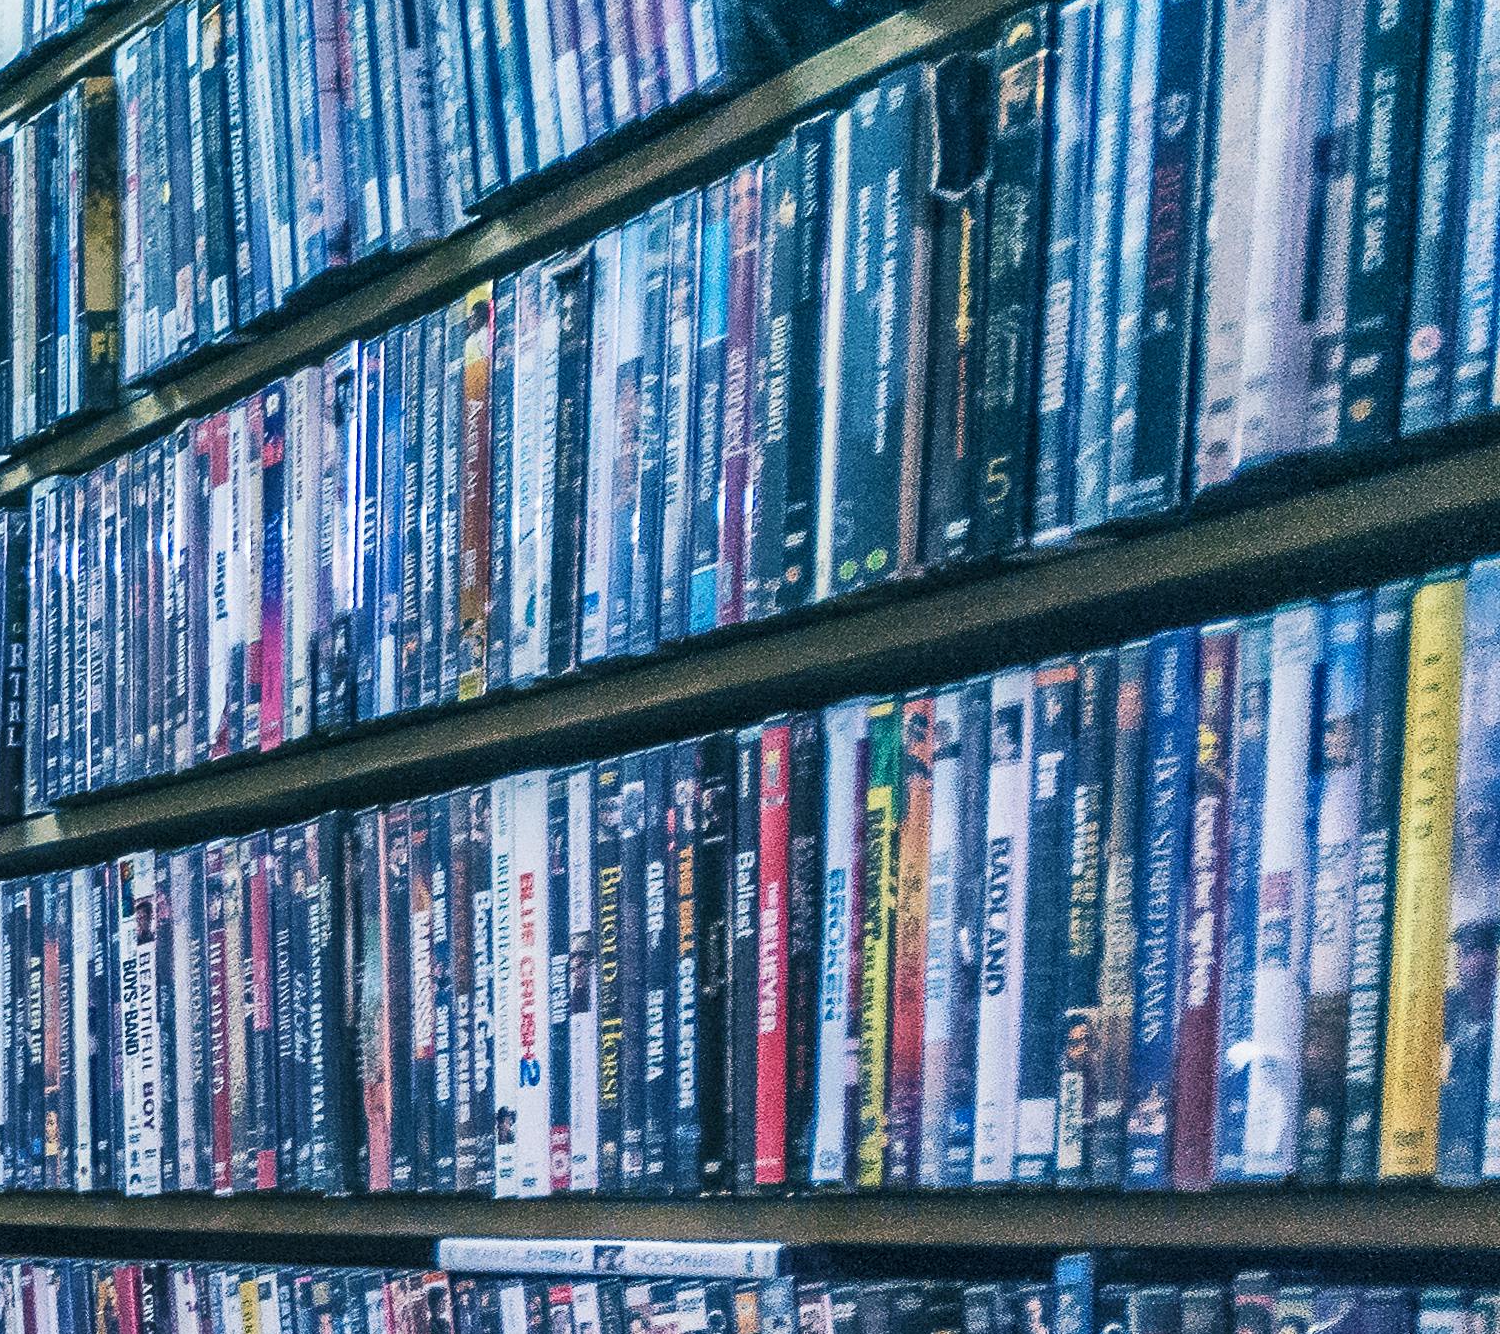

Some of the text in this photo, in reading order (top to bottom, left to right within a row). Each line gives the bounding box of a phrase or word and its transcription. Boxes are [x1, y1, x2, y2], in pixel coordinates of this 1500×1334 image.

[518, 873, 534, 952] BLUE
[1356, 882, 1384, 978] BROWN
[123, 958, 138, 1004] BOYS
[520, 965, 537, 1055] CRUSH
[758, 904, 776, 1035] BELIEVER
[123, 1010, 138, 1060] BAND
[139, 951, 157, 1132] BEAUTIFUL BOY
[1349, 989, 1376, 1083] BUNNY
